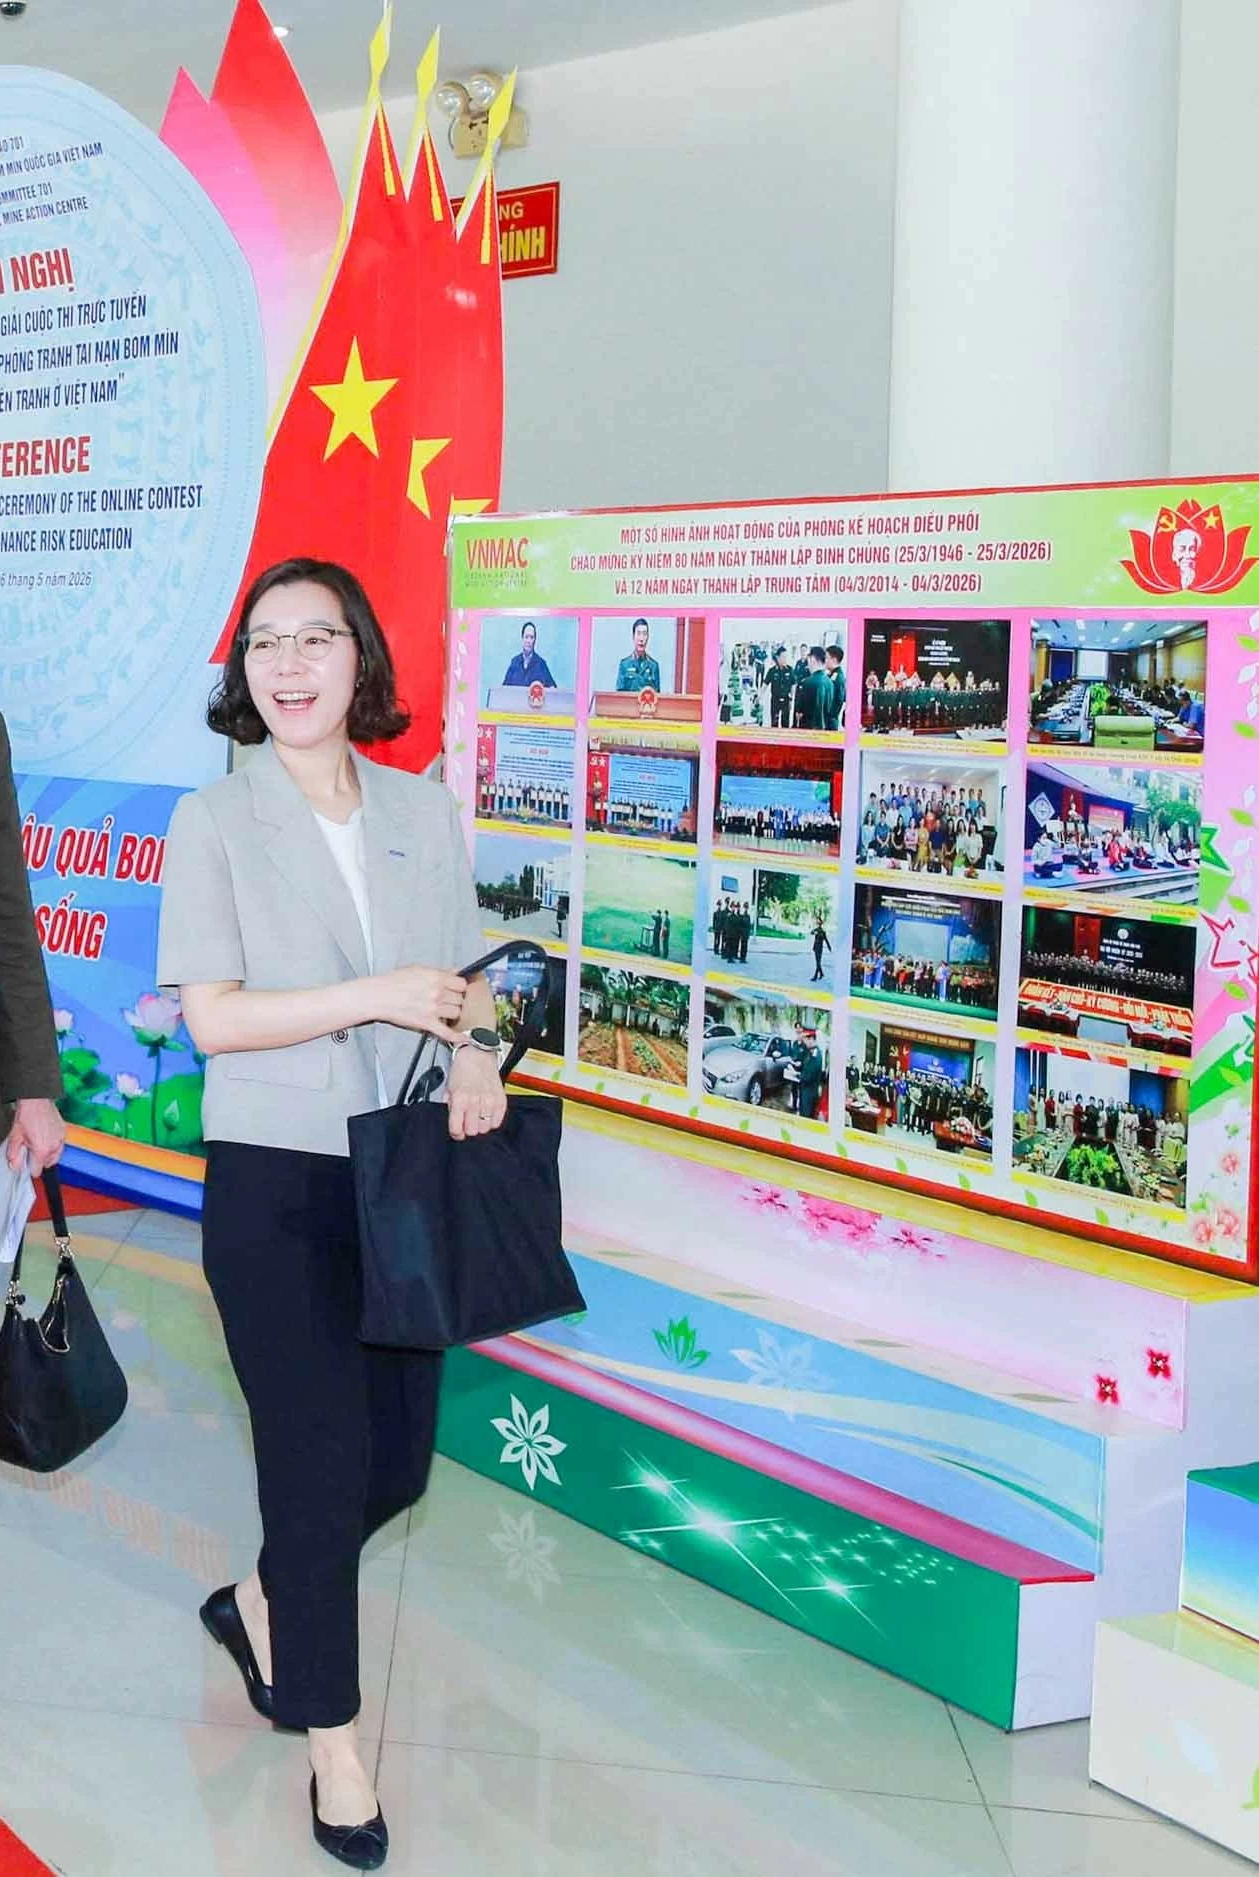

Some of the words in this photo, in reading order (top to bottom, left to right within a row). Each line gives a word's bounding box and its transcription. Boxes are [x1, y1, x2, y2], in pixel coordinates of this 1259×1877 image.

[10, 136, 25, 150] 701
[46, 152, 62, 169] GIA
[82, 142, 103, 159] NAM
[38, 182, 54, 197] 701
[2, 208, 24, 225] MINE
[26, 202, 55, 221] ACTION
[55, 196, 89, 216] CENTRE
[499, 201, 524, 221] NG
[10, 248, 75, 292] NGHỊ
[57, 306, 74, 329] THI
[75, 342, 92, 366] TAI
[95, 339, 120, 367] NẠN
[123, 335, 150, 362] BOM
[16, 384, 50, 411] TRANH
[60, 491, 73, 514] OF
[78, 490, 97, 513] THE
[101, 488, 144, 512] ONLINE
[148, 485, 203, 510] CONTEST
[40, 529, 66, 552] RISK
[70, 528, 132, 551] EDUCATION
[466, 537, 529, 570] VNMAC
[675, 553, 687, 568] 80
[816, 547, 843, 564] BINH
[894, 544, 963, 563] (25/3/1946
[977, 542, 1052, 562] 25/3/2026)
[69, 571, 92, 587] 2026
[631, 580, 643, 594] 12
[765, 576, 802, 593] TRUNG
[835, 574, 899, 594] (04/3/2014
[912, 574, 982, 592] 04/3/2026)
[22, 815, 53, 869] ÂU
[56, 817, 112, 877] QUẢ
[35, 893, 106, 959] SỐNG
